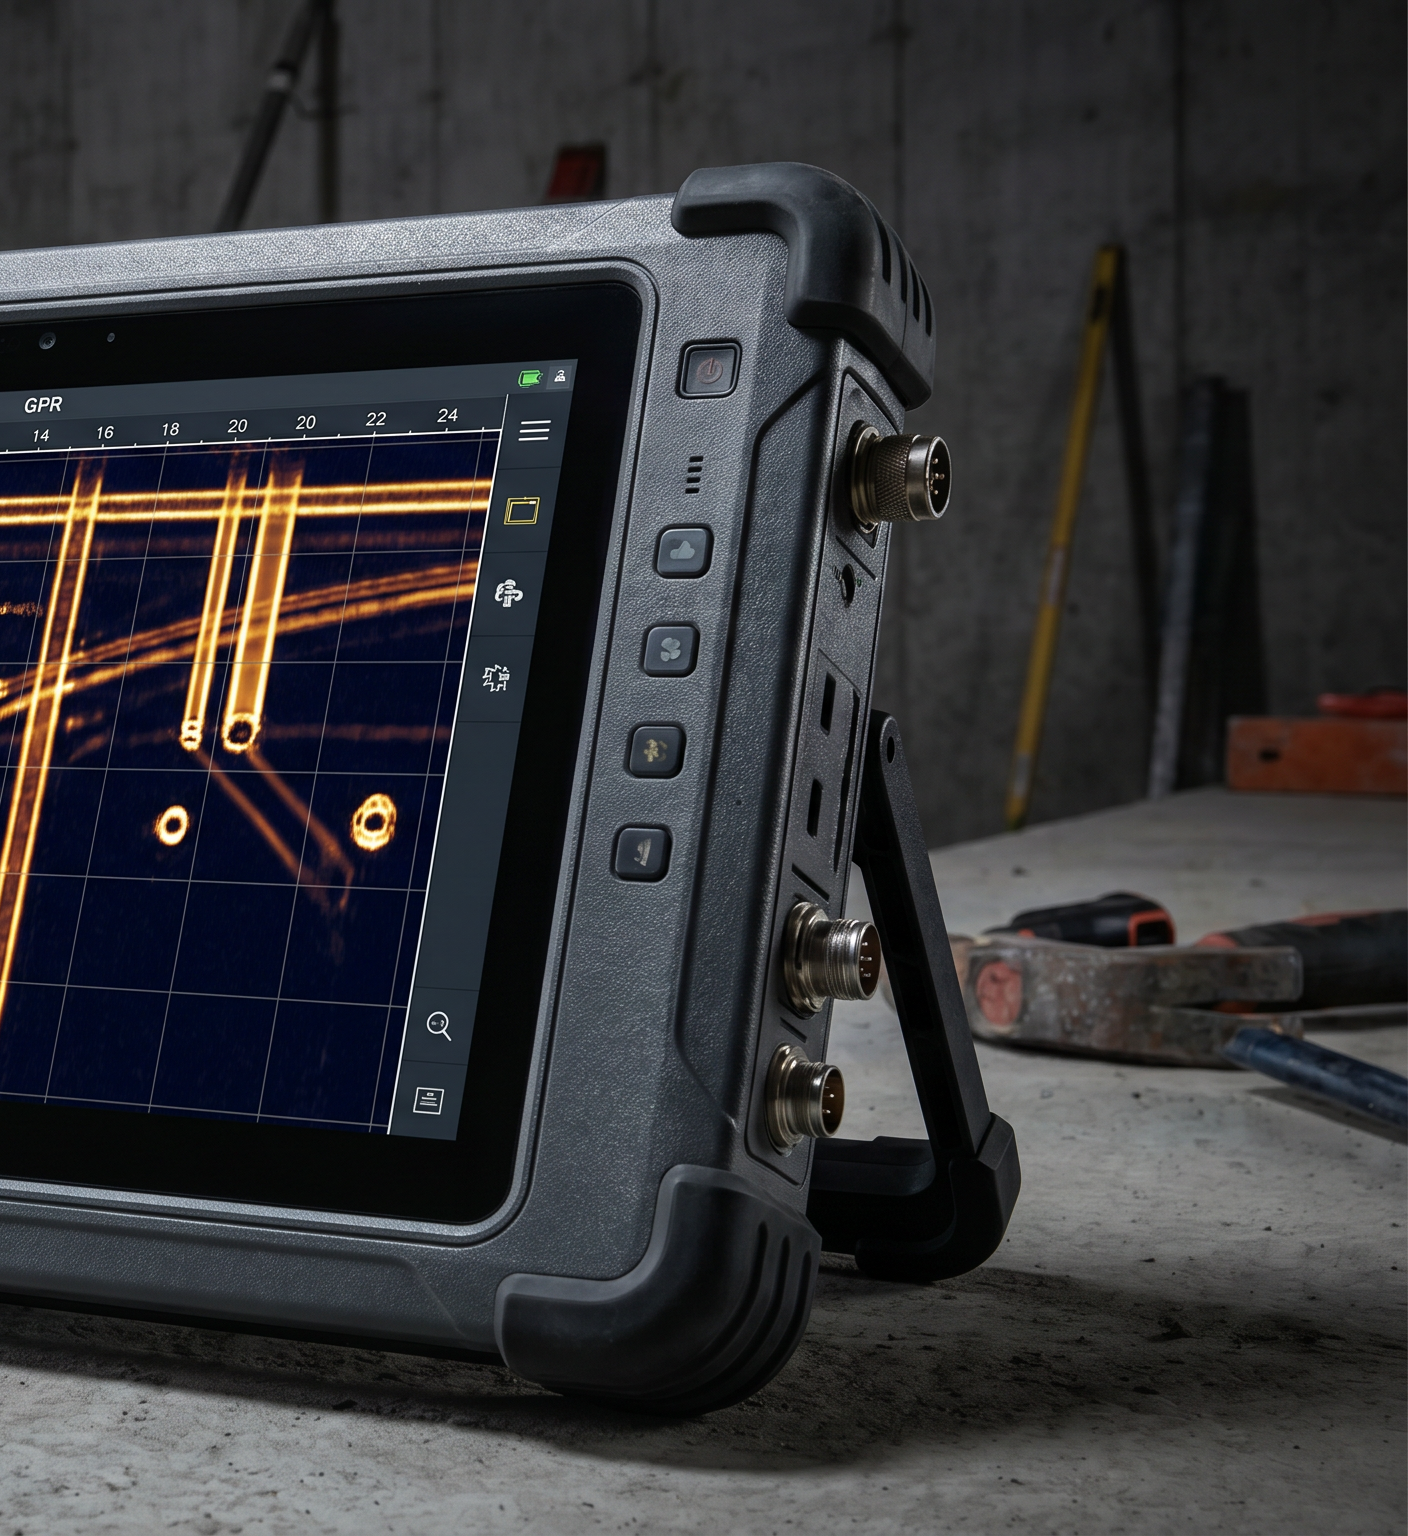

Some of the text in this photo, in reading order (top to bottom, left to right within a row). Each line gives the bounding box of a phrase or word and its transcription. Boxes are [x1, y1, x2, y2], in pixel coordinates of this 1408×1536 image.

[24, 395, 63, 414] GPR
[32, 428, 50, 443] 14
[96, 425, 115, 440] 16
[161, 422, 180, 437] 18
[227, 418, 248, 434] 20
[295, 414, 317, 430] 20
[365, 411, 387, 427] 22
[436, 407, 459, 423] 24
